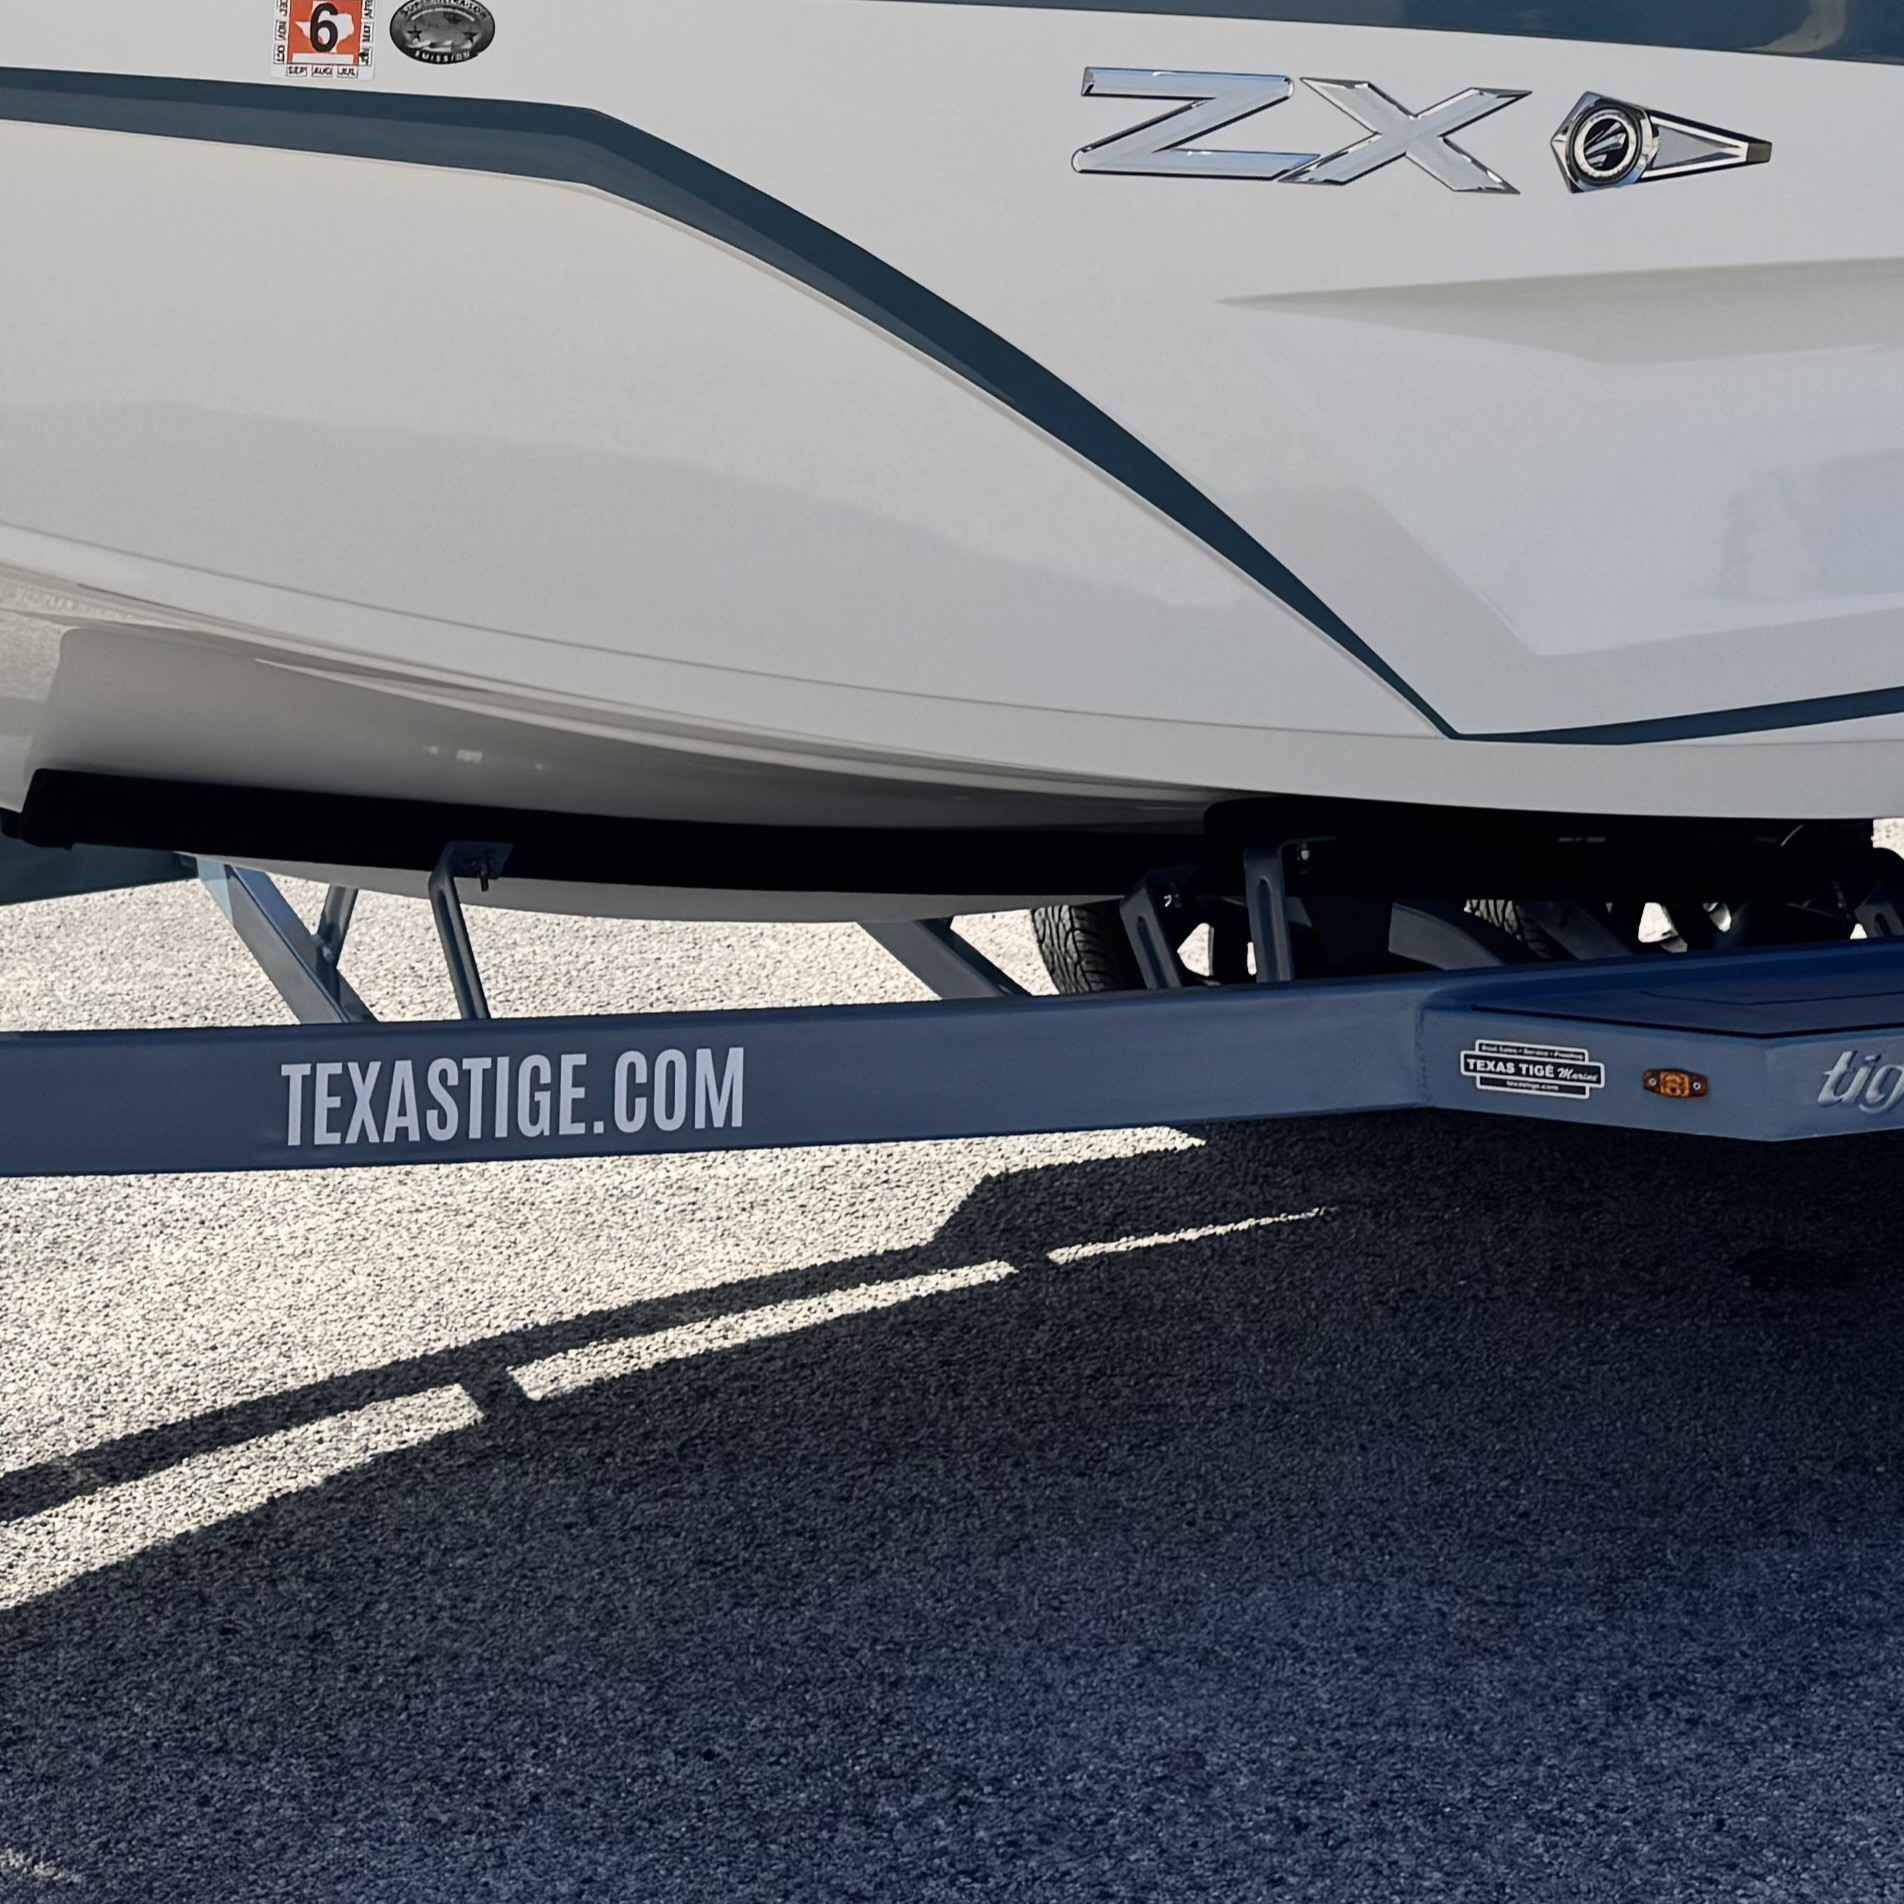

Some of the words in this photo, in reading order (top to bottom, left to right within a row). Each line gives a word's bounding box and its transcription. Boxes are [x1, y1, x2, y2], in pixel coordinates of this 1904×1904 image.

[310, 2, 338, 53] 6
[1071, 66, 1534, 195] ZX
[281, 1047, 744, 1146] TEXASTIGE.COM
[1466, 1058, 1516, 1074] TEXAS
[1519, 1063, 1555, 1078] TIGÉ
